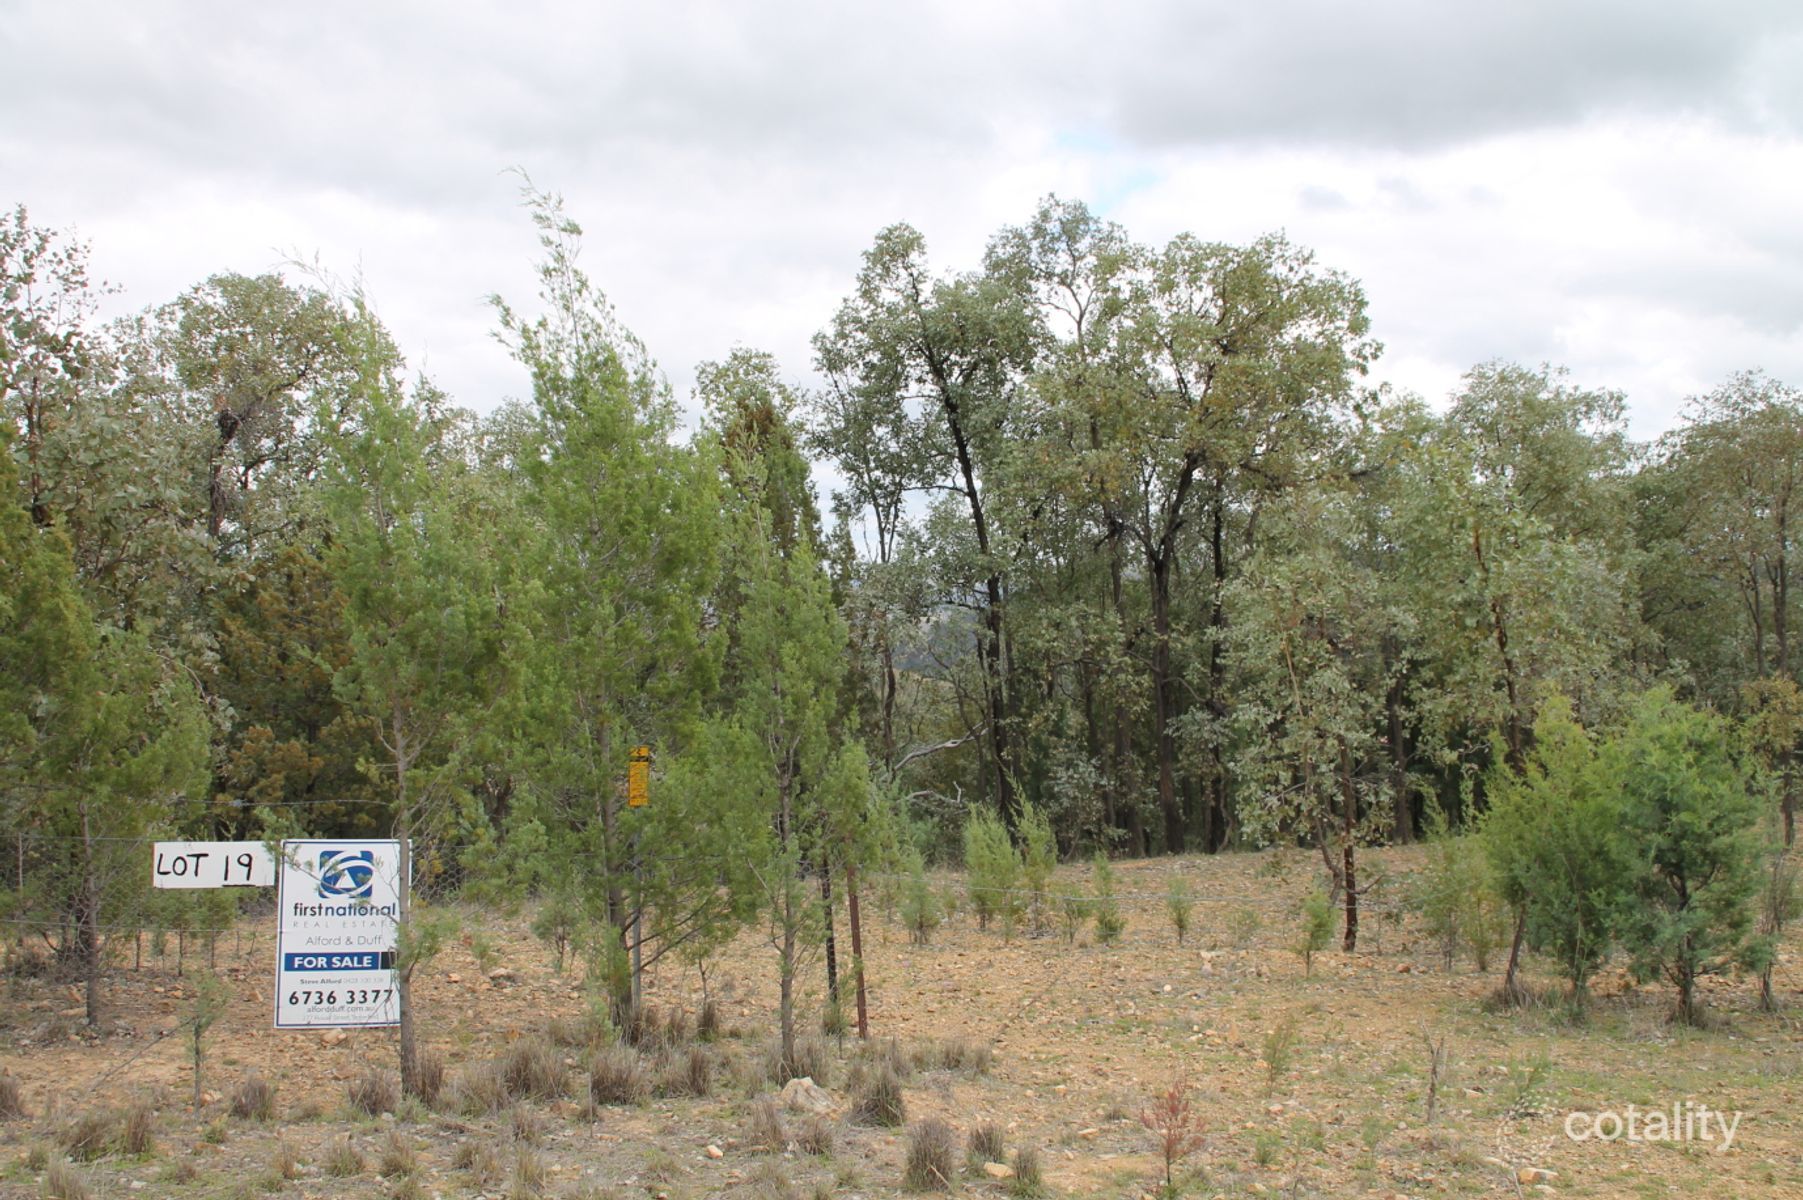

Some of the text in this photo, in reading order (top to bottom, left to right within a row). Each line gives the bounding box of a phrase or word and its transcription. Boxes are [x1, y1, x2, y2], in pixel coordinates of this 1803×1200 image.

[157, 853, 253, 881] LOT 19
[293, 920, 330, 928] REAL
[305, 935, 382, 946] Alford & Duff
[294, 955, 373, 969] FOR SALE
[288, 989, 393, 1005] 6736 3377
